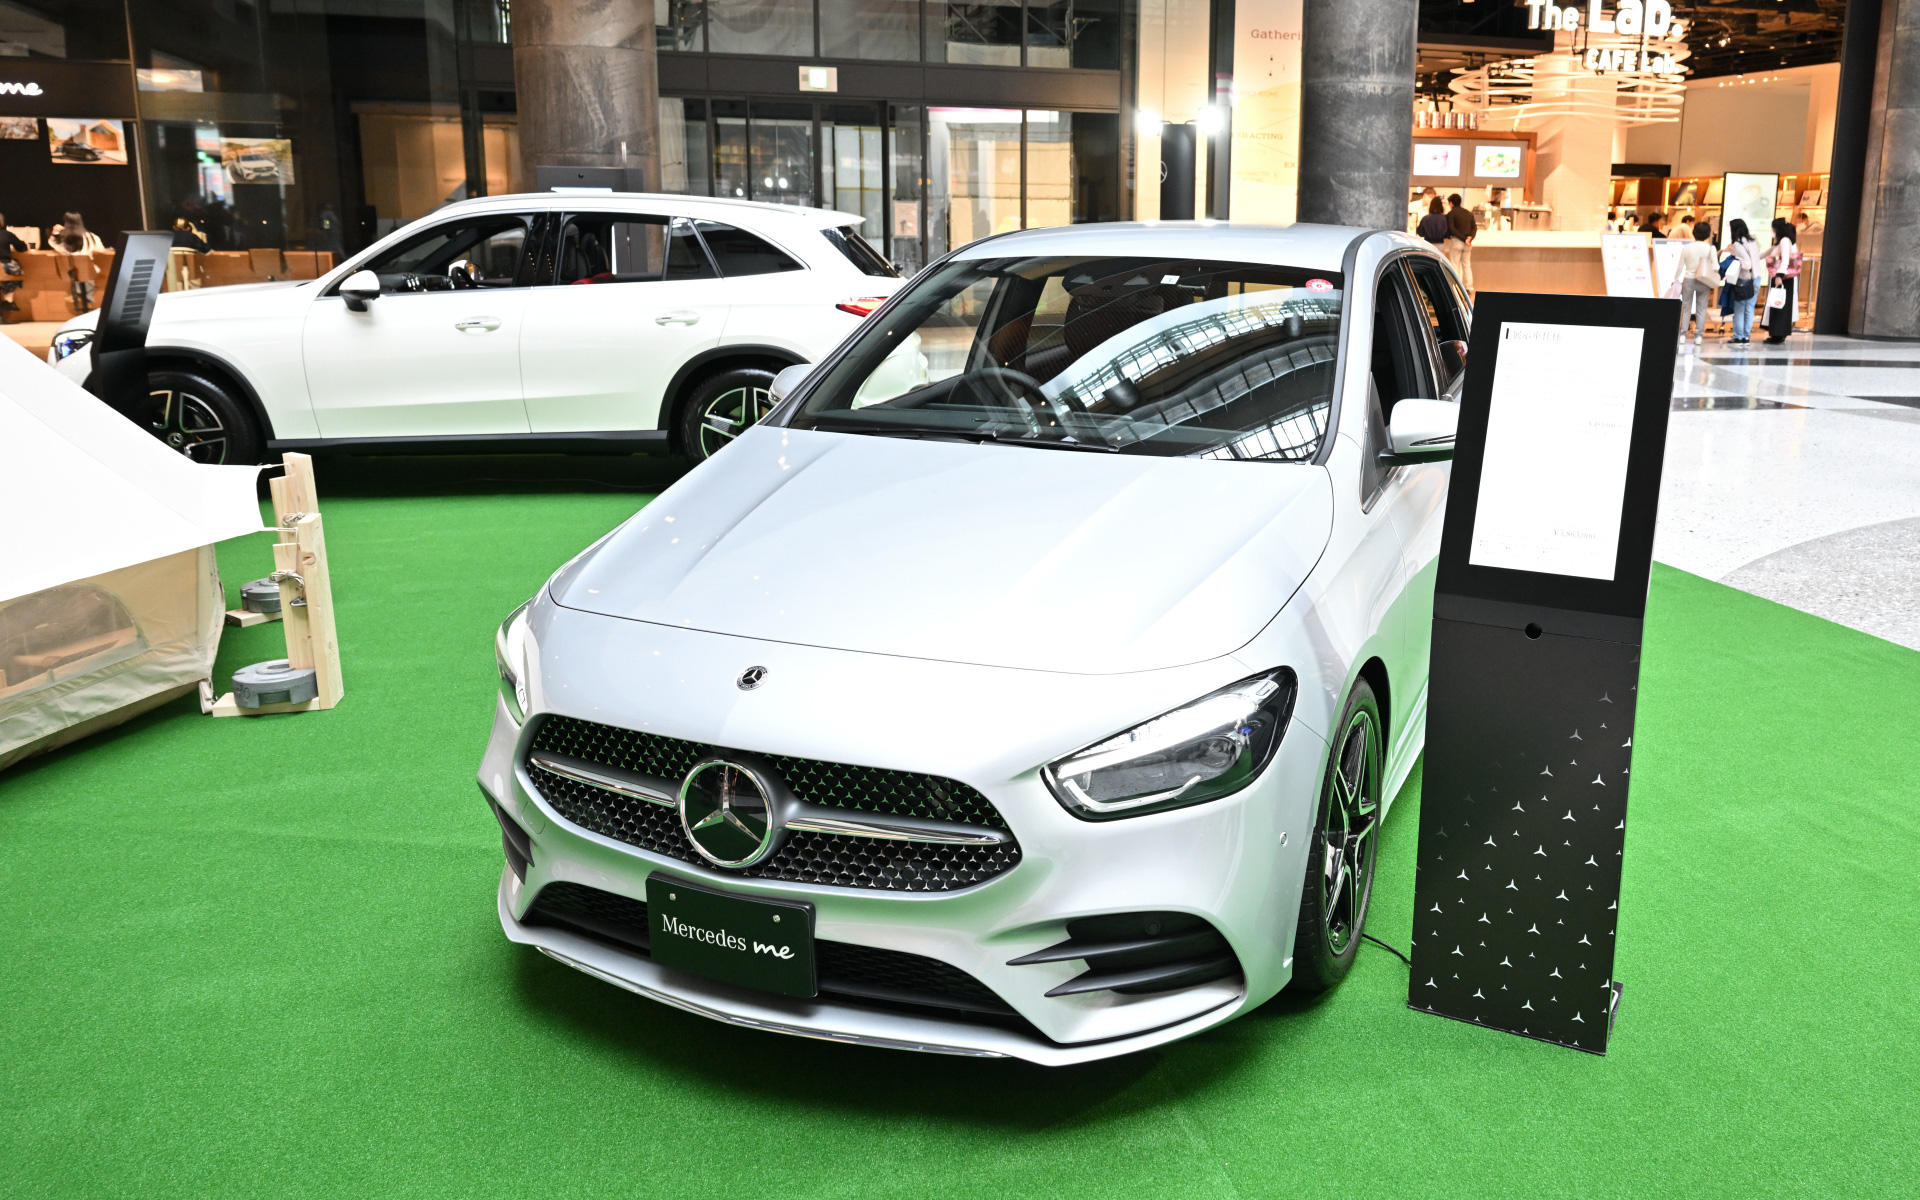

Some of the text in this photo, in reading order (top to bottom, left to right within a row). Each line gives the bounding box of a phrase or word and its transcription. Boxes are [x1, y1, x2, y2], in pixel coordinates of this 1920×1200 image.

[1525, 0, 1683, 37] The Lab.
[1584, 48, 1680, 74] CAFE Lab.
[661, 913, 795, 960] Mercedes me
